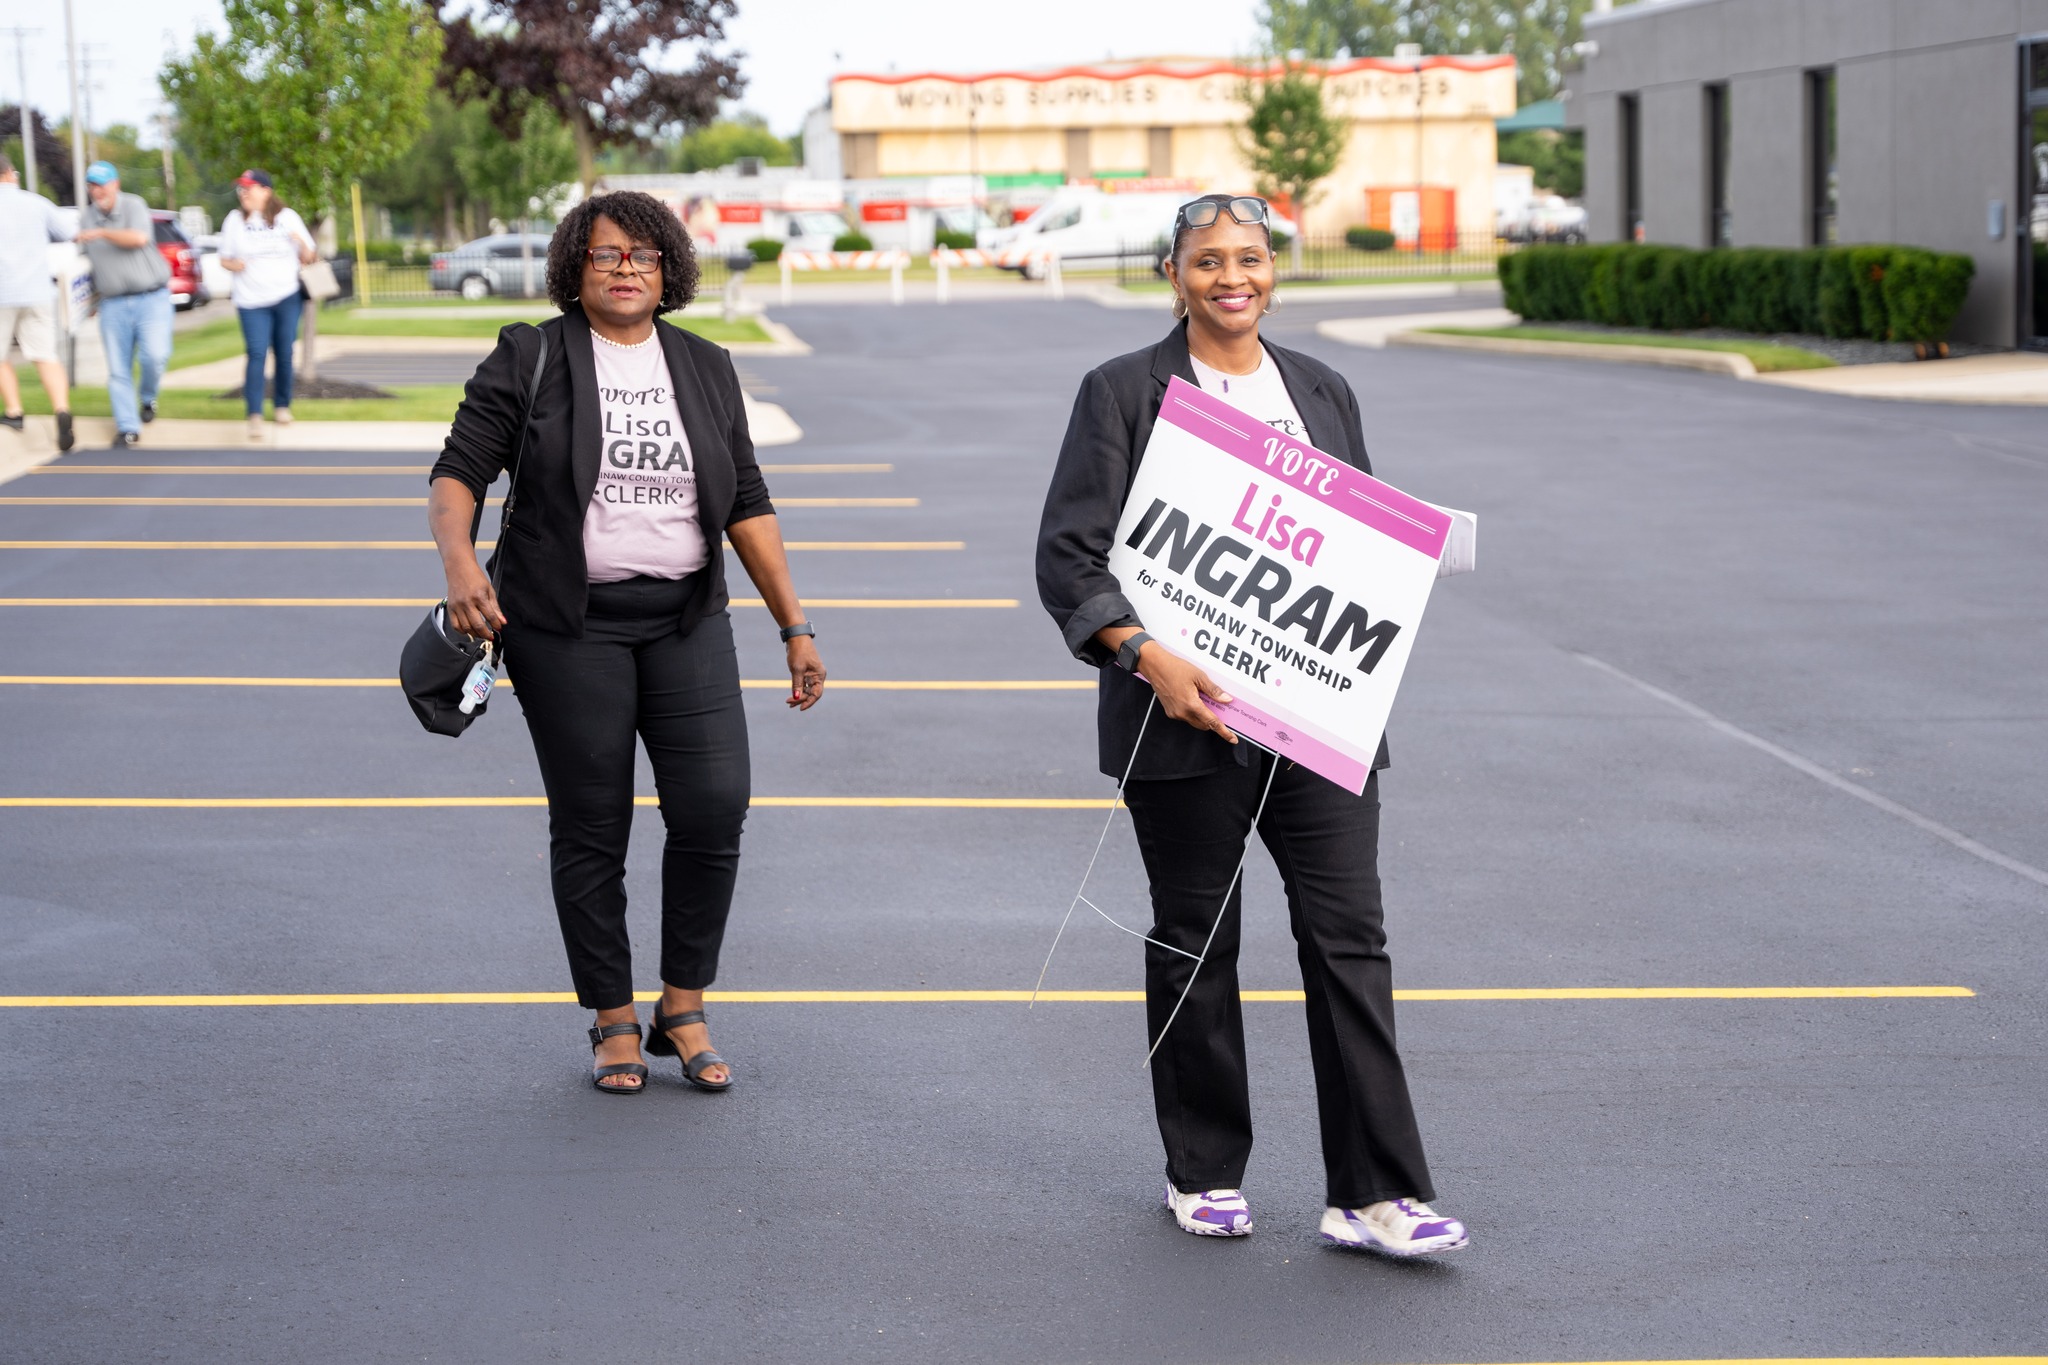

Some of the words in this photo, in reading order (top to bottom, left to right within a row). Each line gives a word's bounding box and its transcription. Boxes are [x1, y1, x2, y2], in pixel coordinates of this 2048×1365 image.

[1029, 82, 1155, 105] SUPPLIES
[600, 387, 667, 405] VOTE
[606, 411, 671, 436] Lisa
[602, 438, 690, 472] GRA
[1263, 437, 1339, 496] VOTE
[600, 472, 627, 480] INAW
[628, 474, 668, 483] COUNTY
[603, 484, 678, 504] CLERK
[1231, 481, 1325, 567] Lisa
[1125, 497, 1402, 675] INGRAM
[1136, 568, 1159, 588] for
[1160, 581, 1247, 638] SAGINAW
[1250, 628, 1353, 692] TOWNSHIP
[1194, 629, 1272, 684] CLERK
